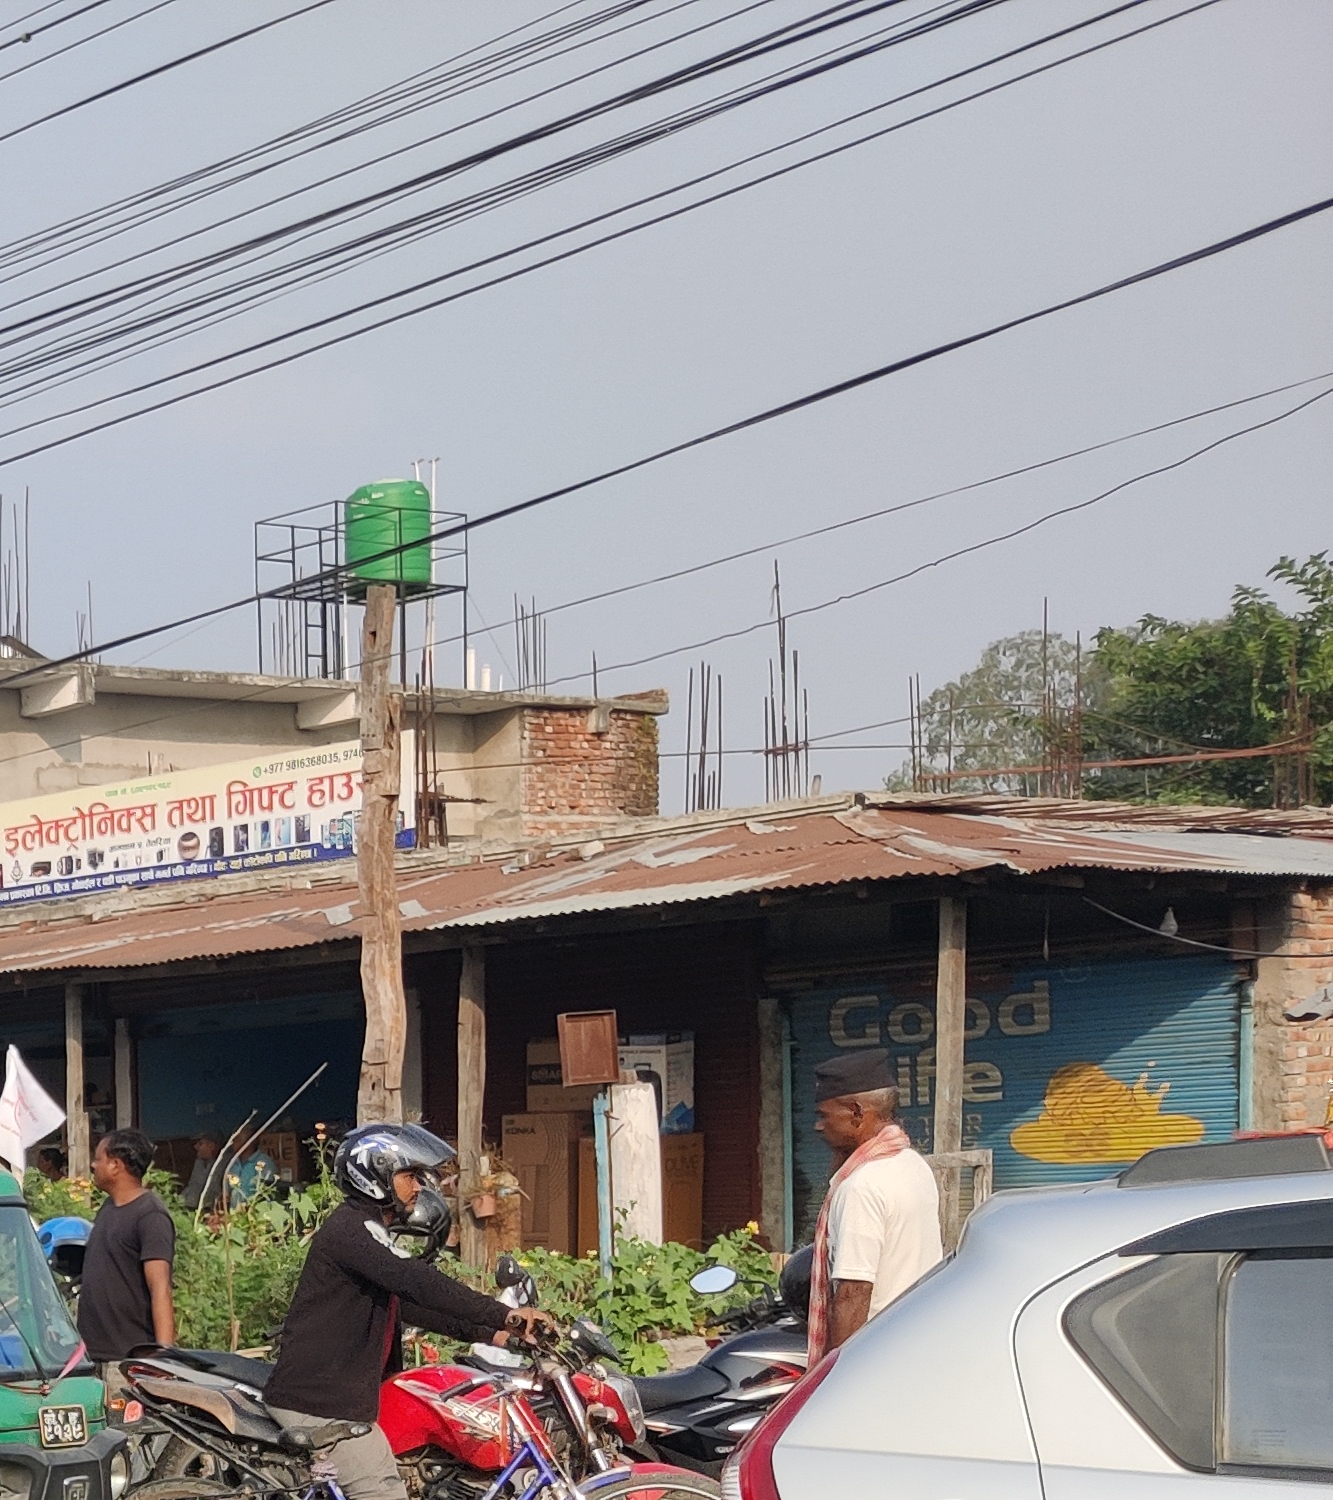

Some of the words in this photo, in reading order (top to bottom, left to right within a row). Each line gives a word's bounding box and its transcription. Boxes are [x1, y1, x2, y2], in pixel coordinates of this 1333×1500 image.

[263, 761, 283, 775] +977
[4, 802, 157, 858] इलेक्ट्रोनिक्स
[166, 794, 217, 829] तथा
[226, 780, 298, 820] गिफ्ट
[829, 980, 1051, 1047] Good
[896, 1047, 1003, 1108] ife
[505, 1126, 536, 1135] KONKA
